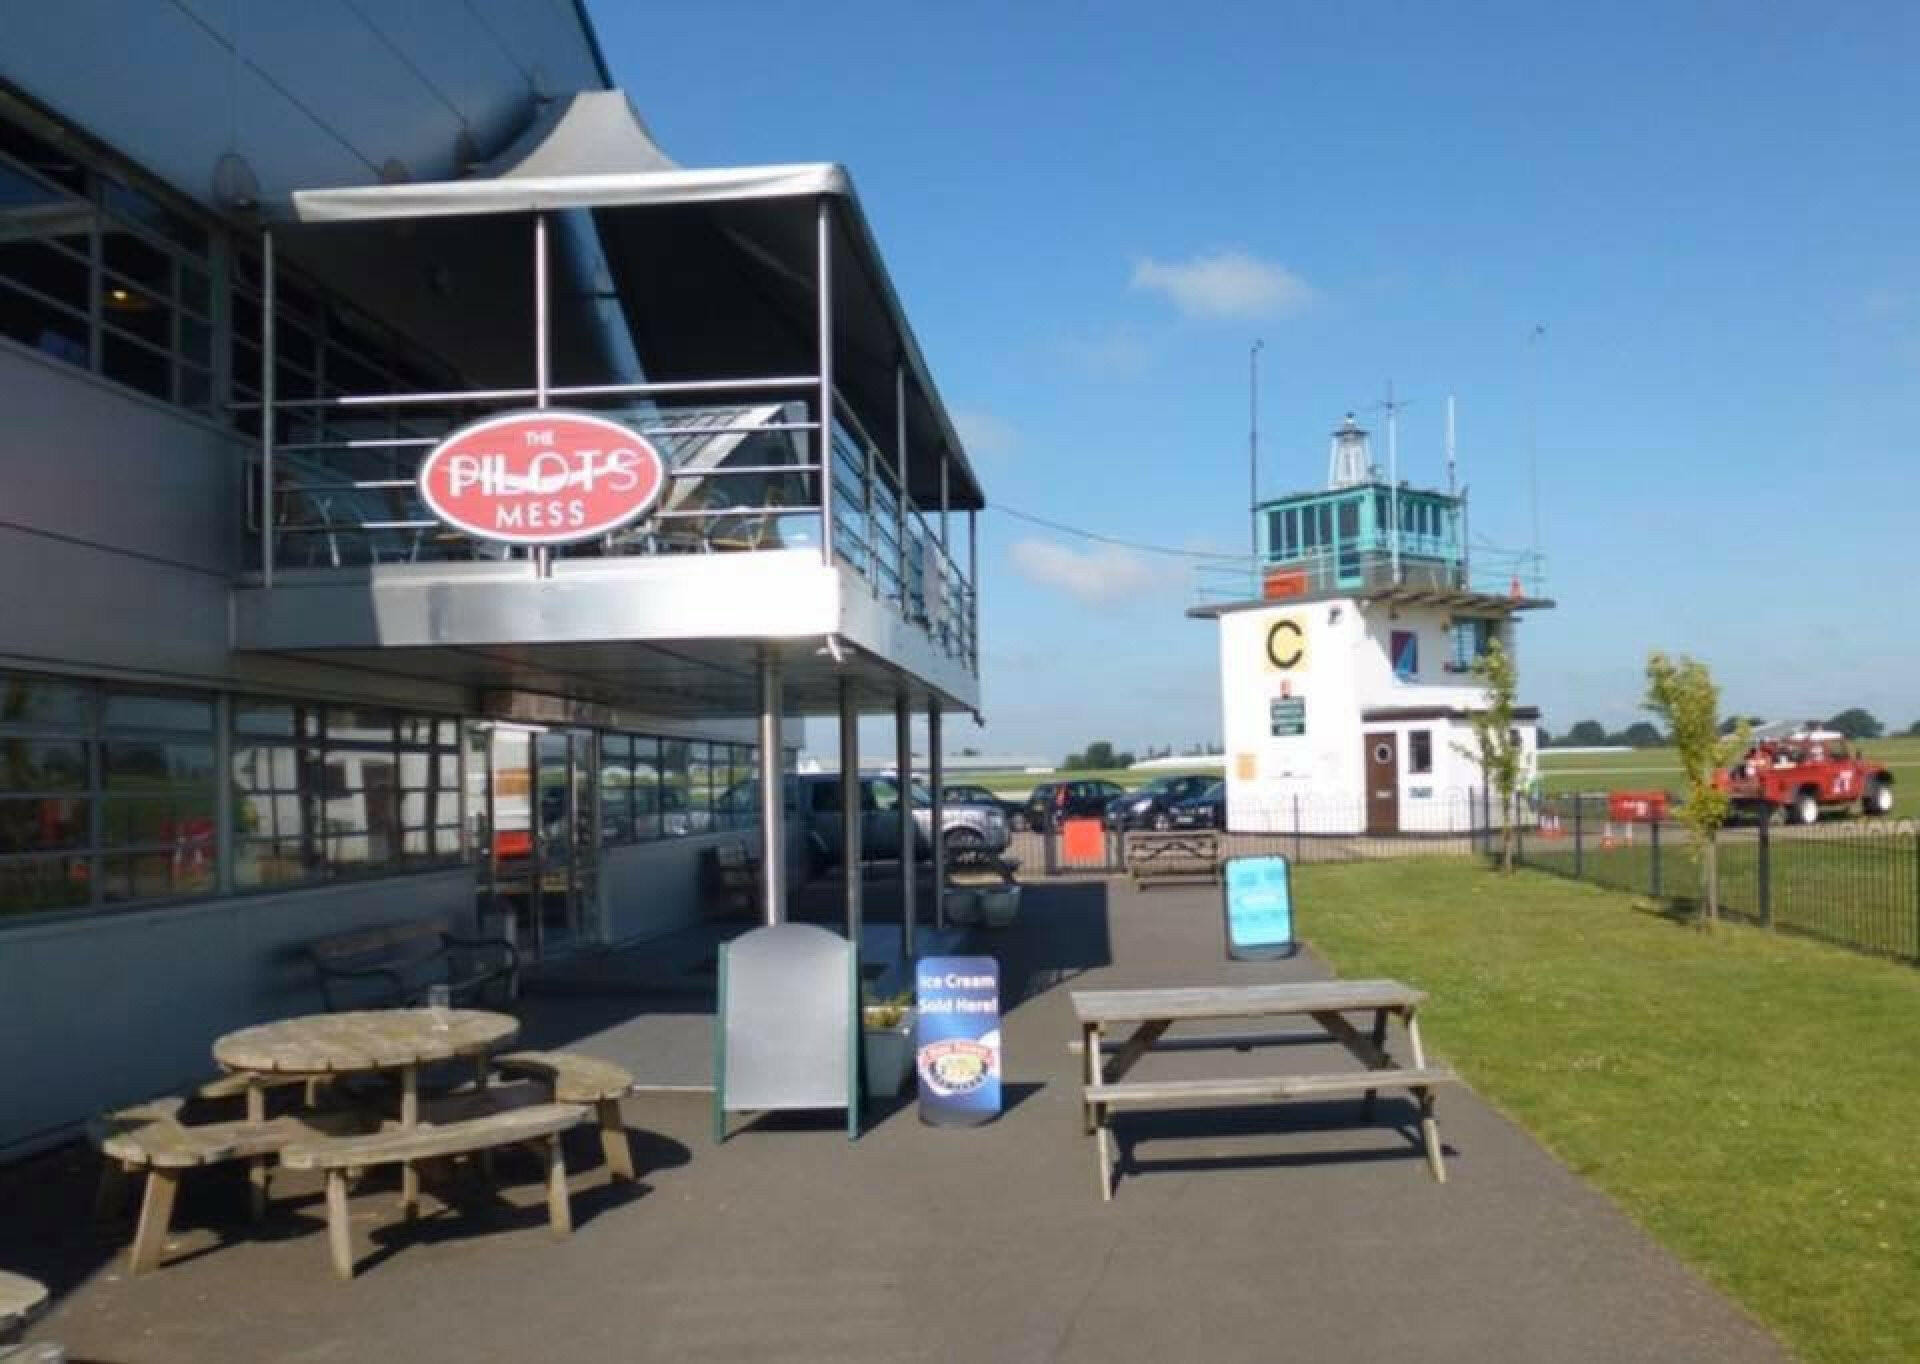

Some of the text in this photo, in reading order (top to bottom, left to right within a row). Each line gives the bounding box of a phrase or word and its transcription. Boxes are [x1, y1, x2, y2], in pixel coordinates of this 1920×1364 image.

[527, 431, 556, 446] THE
[449, 448, 642, 497] PILOTS
[495, 501, 587, 529] MESS
[1266, 619, 1303, 669] C
[946, 974, 996, 989] Cream
